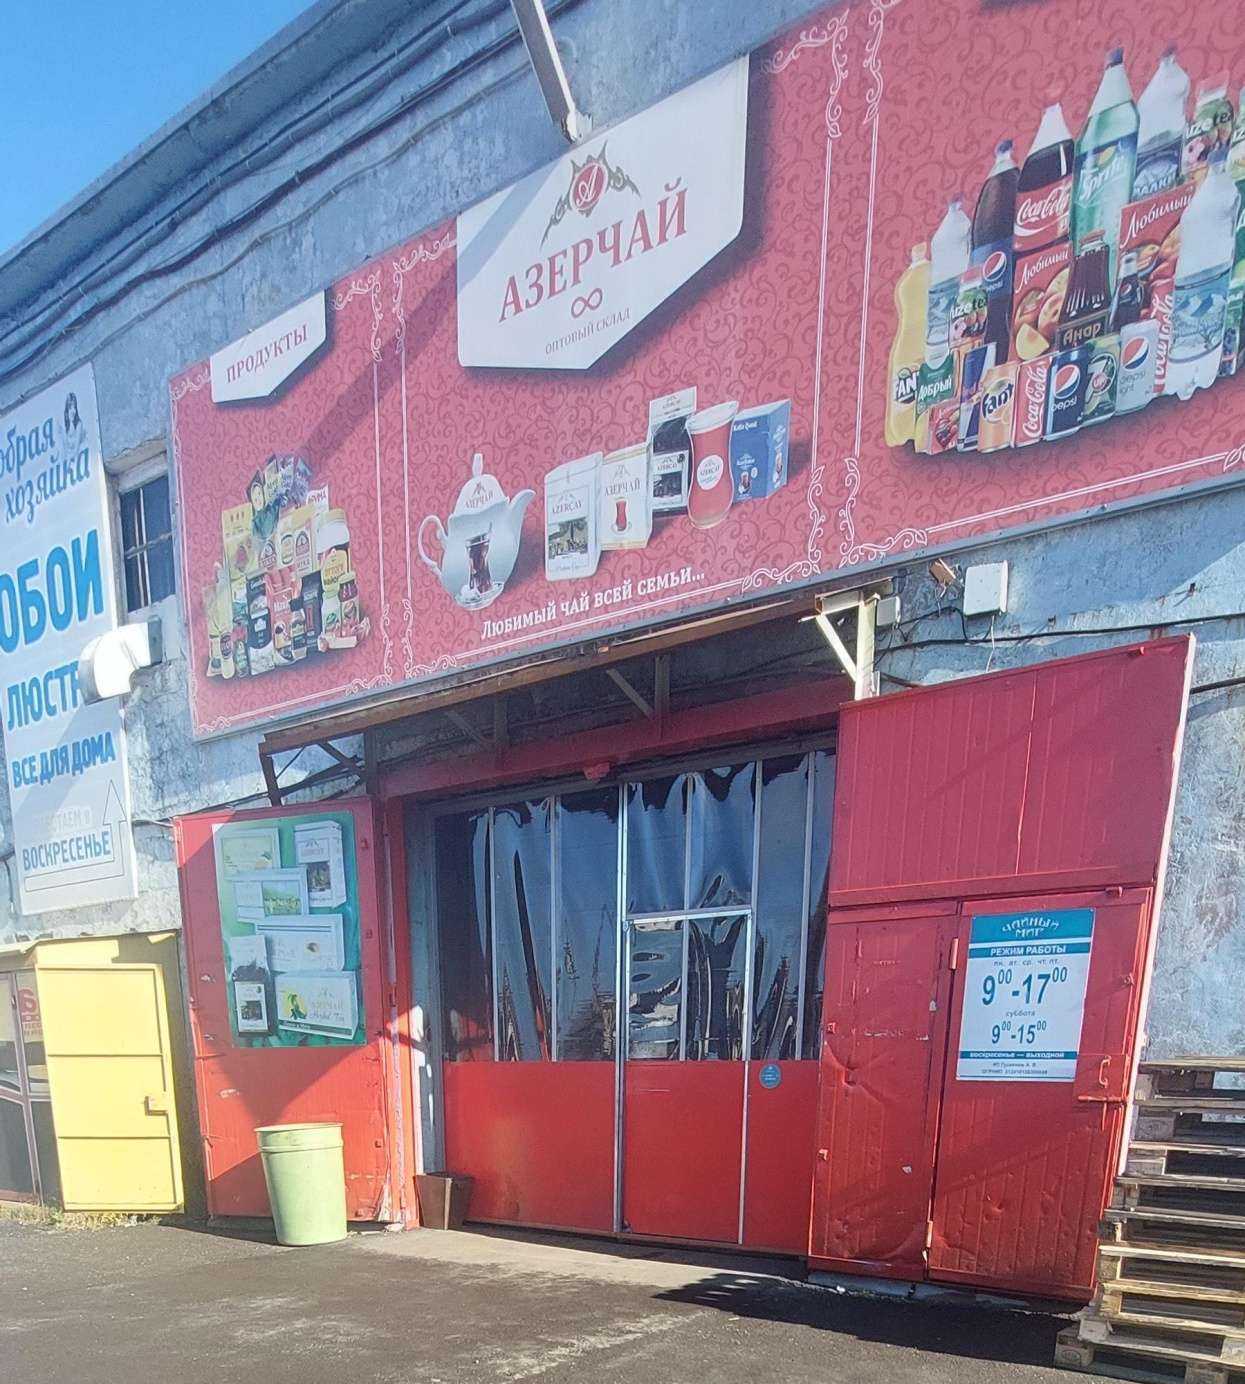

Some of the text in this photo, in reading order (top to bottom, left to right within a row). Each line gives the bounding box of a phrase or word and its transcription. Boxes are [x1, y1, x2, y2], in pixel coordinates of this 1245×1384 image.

[498, 176, 688, 323] АЗЕРЧАЙ
[226, 323, 309, 384] ПРОДУКТЫ
[918, 374, 952, 402] Добрый
[1051, 395, 1078, 412] pepsi
[5, 447, 90, 523] хозяйка
[0, 529, 104, 653] ОБОИ
[560, 590, 590, 617] ЧАЙ
[594, 580, 633, 609] ВСЕЙ
[12, 731, 116, 789] ВСЕ ДЛЯ ДОМА
[22, 831, 111, 871] ВОСКРЕСЕНЬЕ
[990, 944, 1067, 956] РЕЖИМ РАБОТЫ
[1006, 1009, 1036, 1018] суббота
